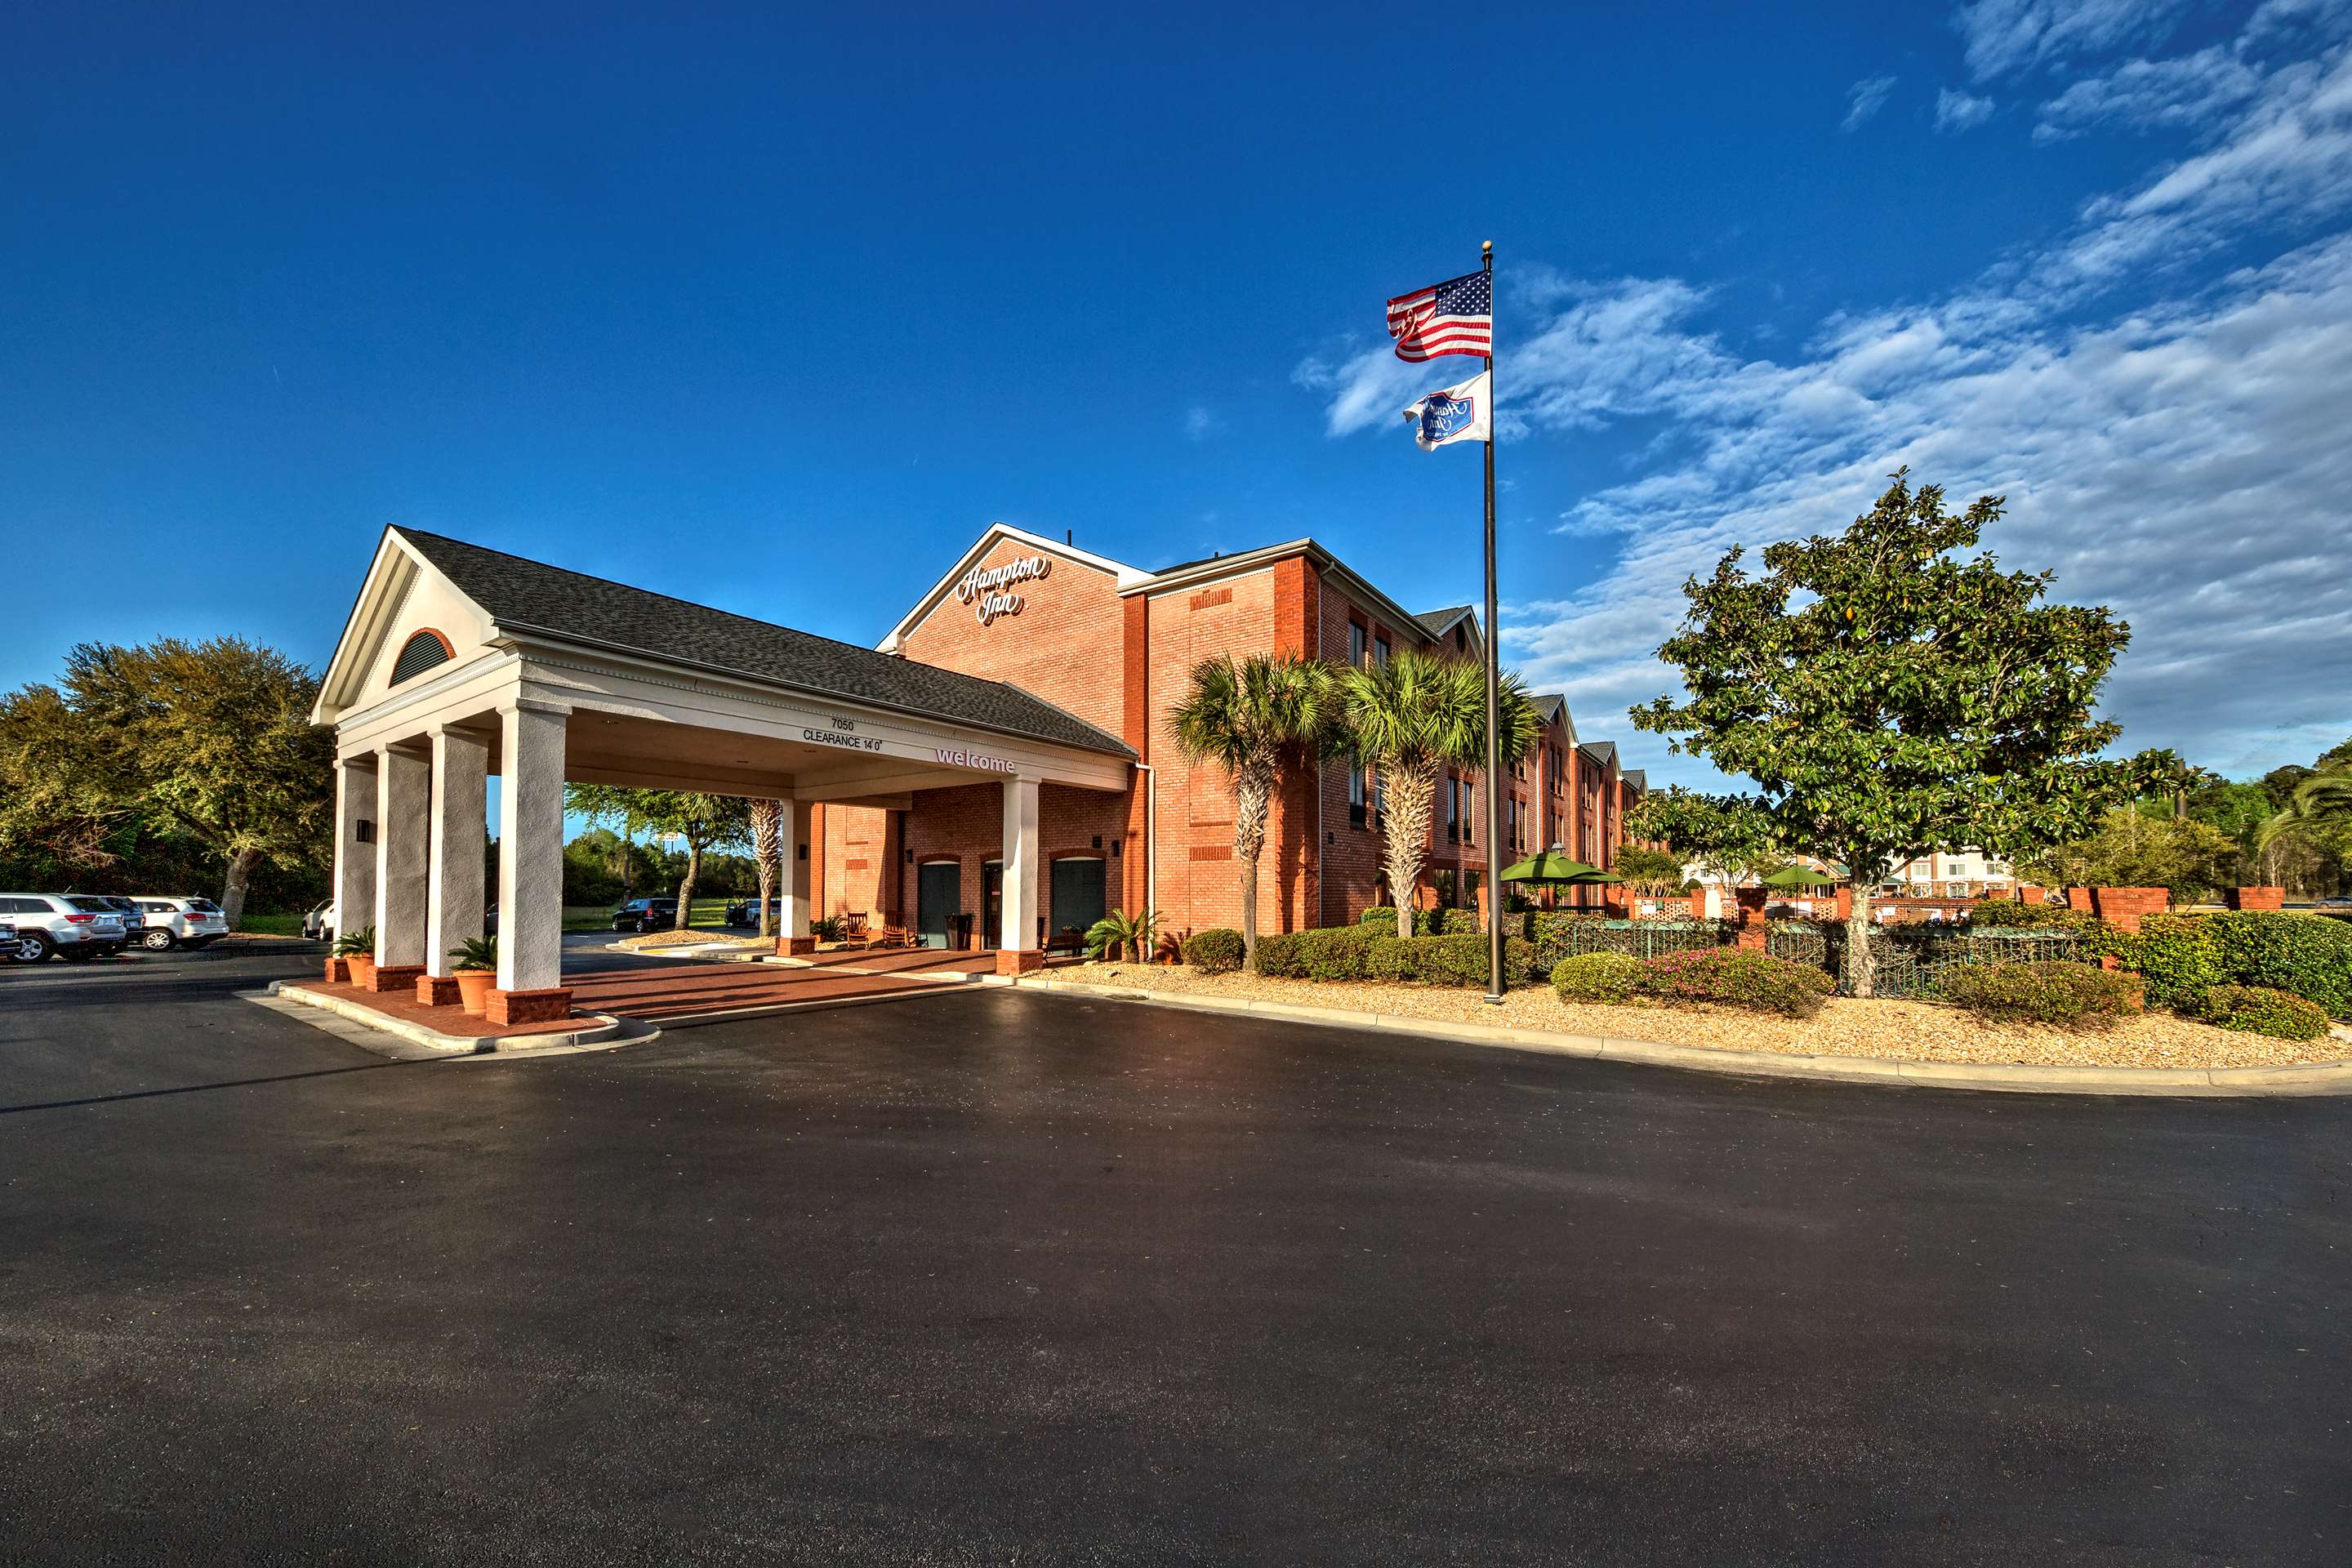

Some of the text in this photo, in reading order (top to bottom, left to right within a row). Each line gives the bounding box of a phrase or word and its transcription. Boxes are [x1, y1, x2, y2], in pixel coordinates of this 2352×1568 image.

[956, 556, 1047, 601] Hampton
[976, 591, 1020, 623] Inn
[831, 719, 854, 731] 7050
[804, 729, 860, 748] CLEARANCE
[936, 749, 1015, 773] welcome
